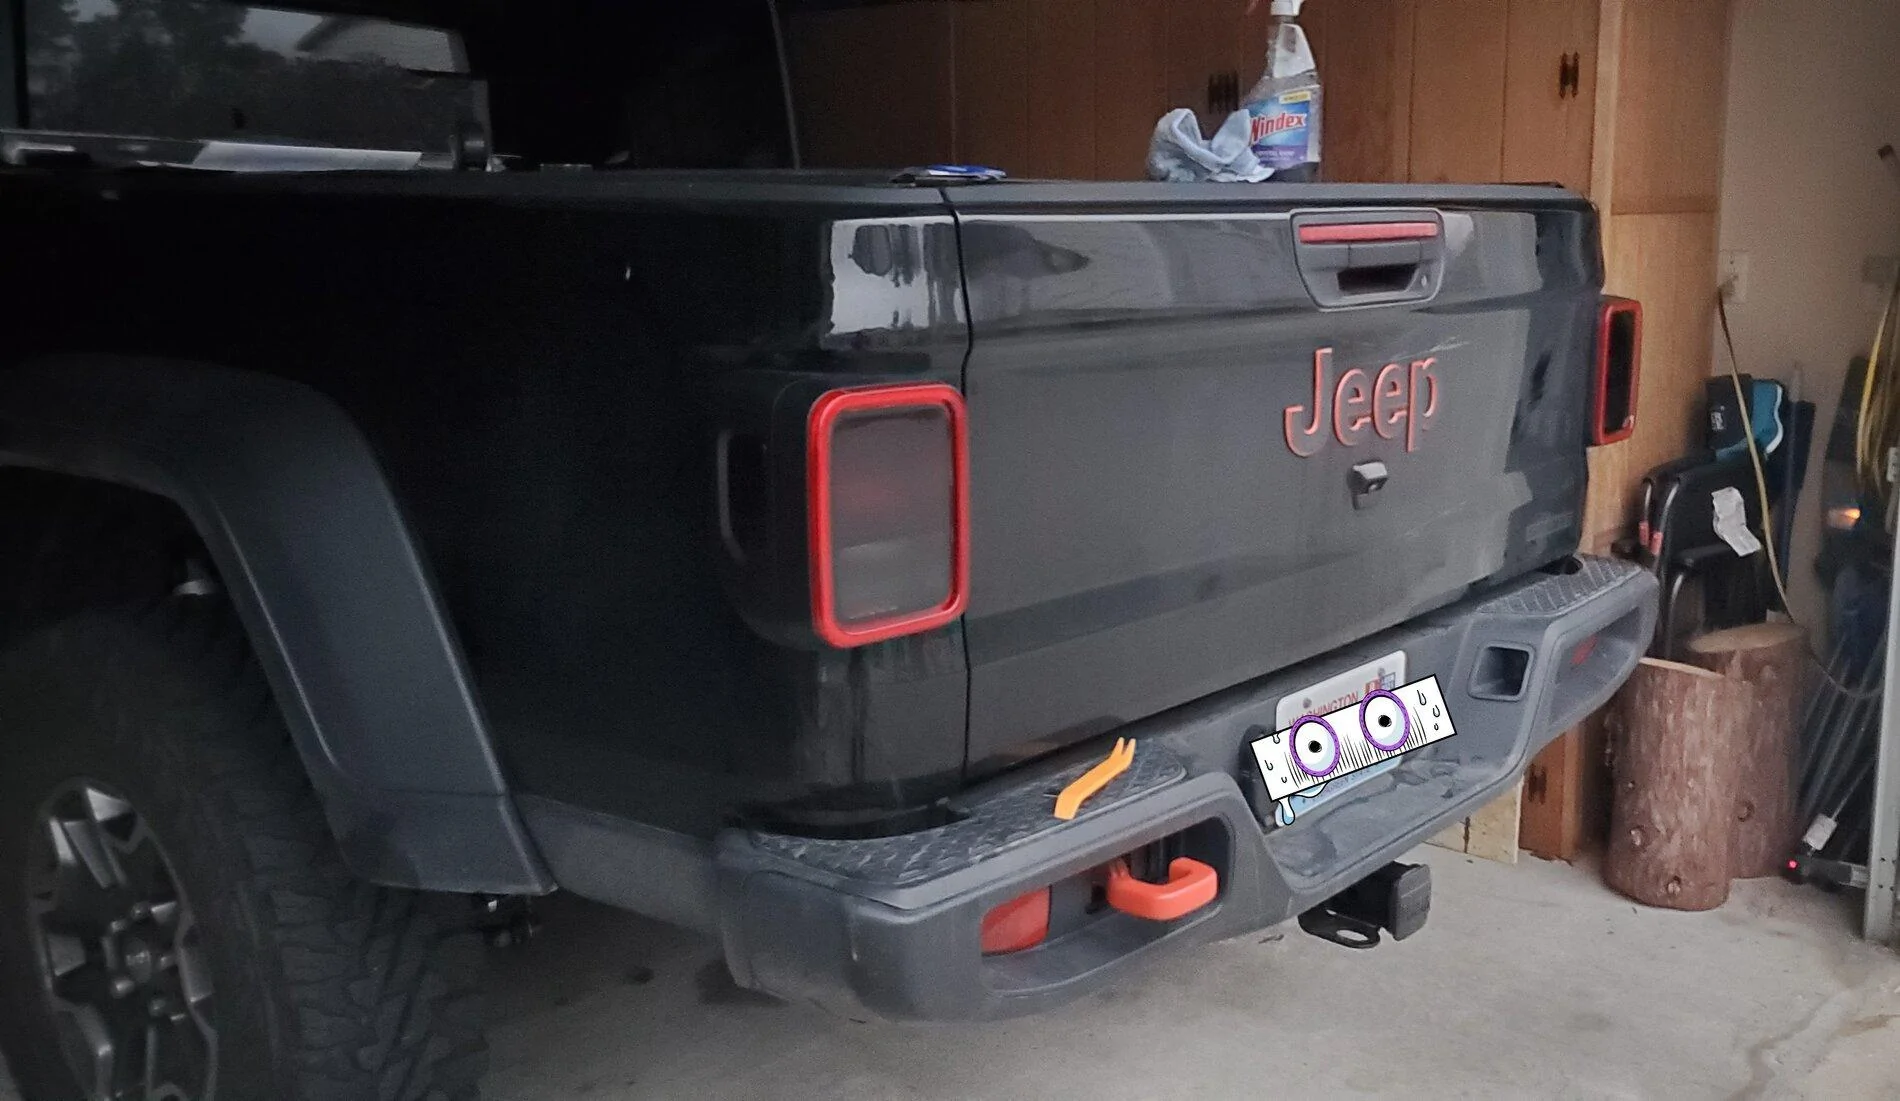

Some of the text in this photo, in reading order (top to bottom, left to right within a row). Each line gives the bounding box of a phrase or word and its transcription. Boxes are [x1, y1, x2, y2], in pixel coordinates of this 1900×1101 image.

[1251, 112, 1305, 143] Windex
[1284, 347, 1438, 457] Jeep
[1288, 690, 1359, 726] WHINGTON
